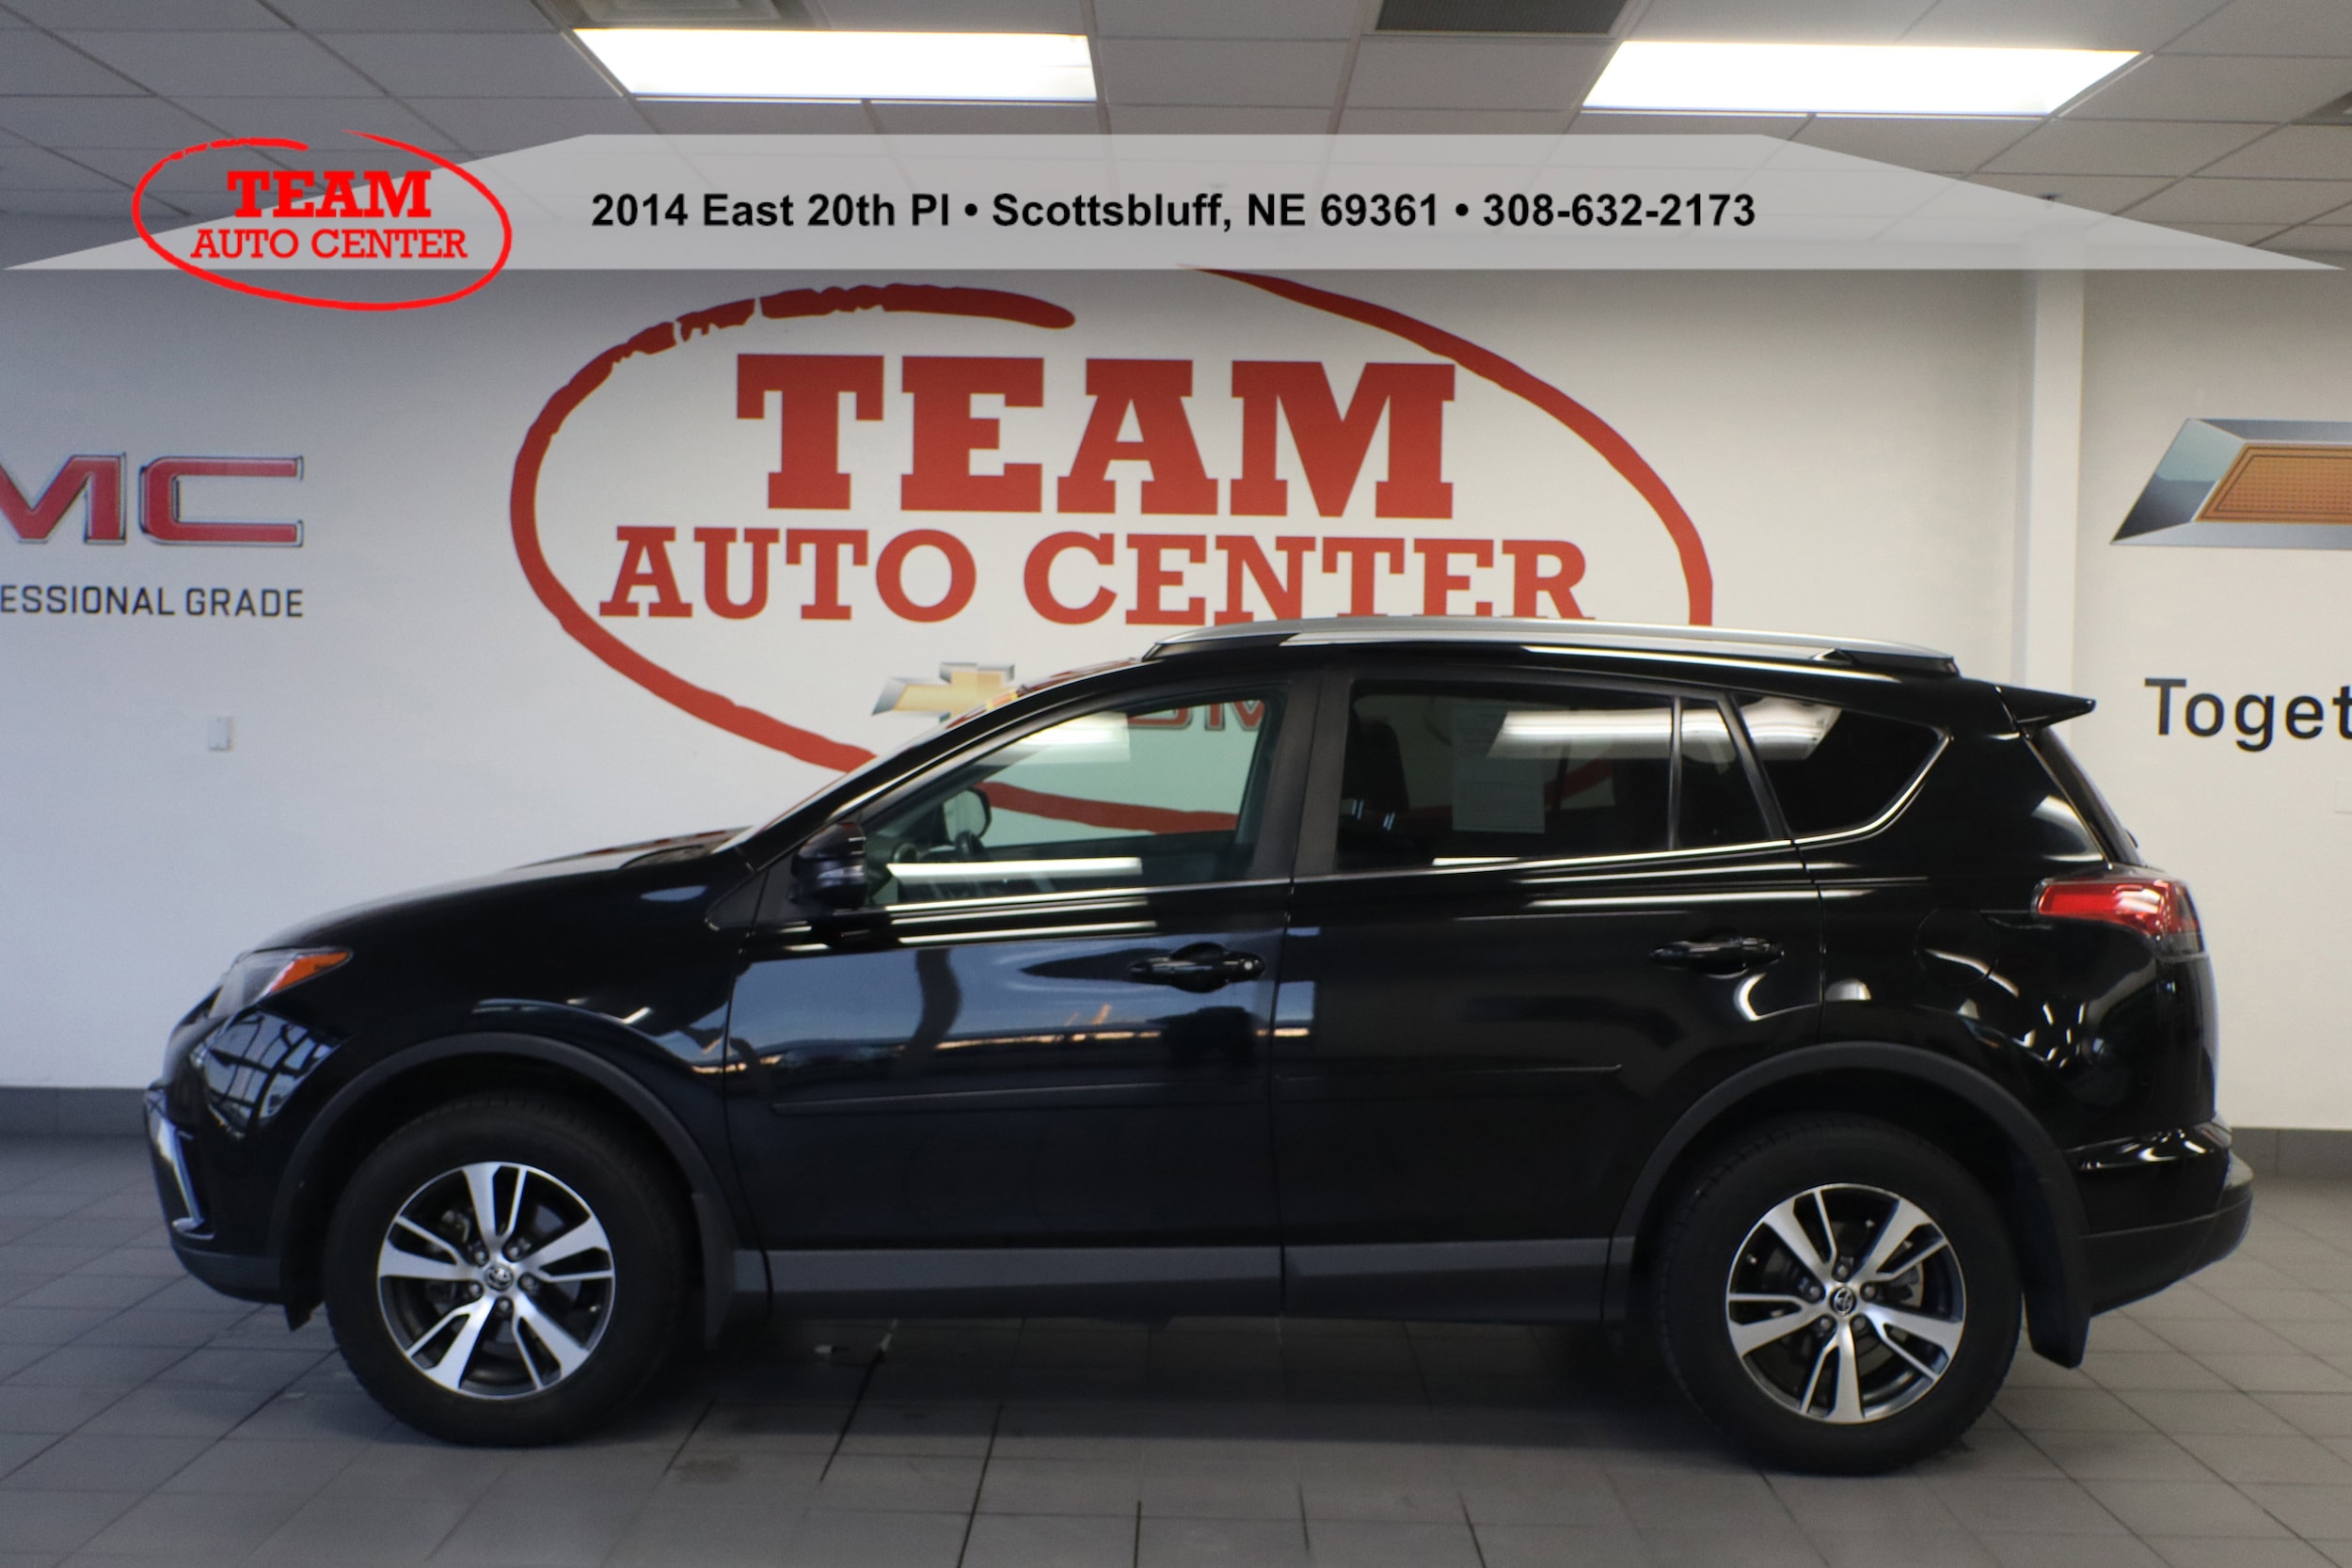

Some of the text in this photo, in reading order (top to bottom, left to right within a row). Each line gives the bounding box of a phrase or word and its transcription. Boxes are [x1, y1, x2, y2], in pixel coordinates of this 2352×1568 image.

[737, 353, 1454, 520] TEAM
[185, 587, 304, 618] GRADE
[598, 525, 1597, 626] AUTO CENTER
